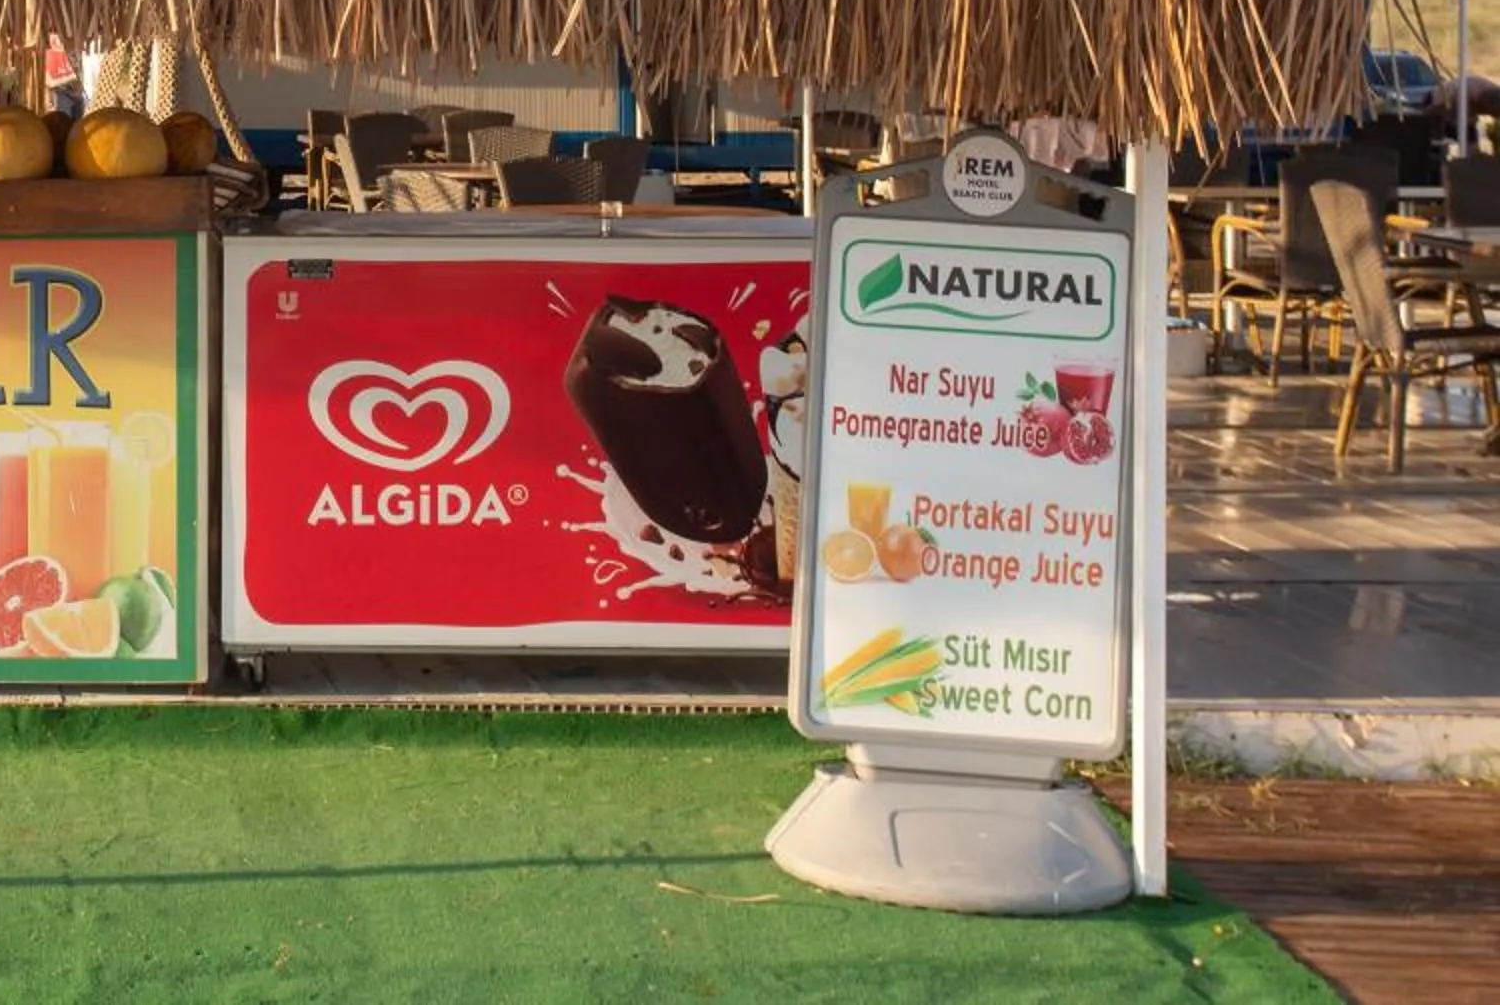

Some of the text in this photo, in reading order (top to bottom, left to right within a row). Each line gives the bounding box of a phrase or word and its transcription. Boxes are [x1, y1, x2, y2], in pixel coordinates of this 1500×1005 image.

[907, 263, 1103, 306] NATURAL
[889, 364, 995, 409] Nar Suyu
[832, 406, 1049, 450] Pomegranate Juice
[913, 495, 1114, 546] Portakal Suyu
[920, 545, 1104, 589] Orange Juice
[944, 634, 991, 668] Süt
[921, 677, 1092, 721] Sweet Corn
